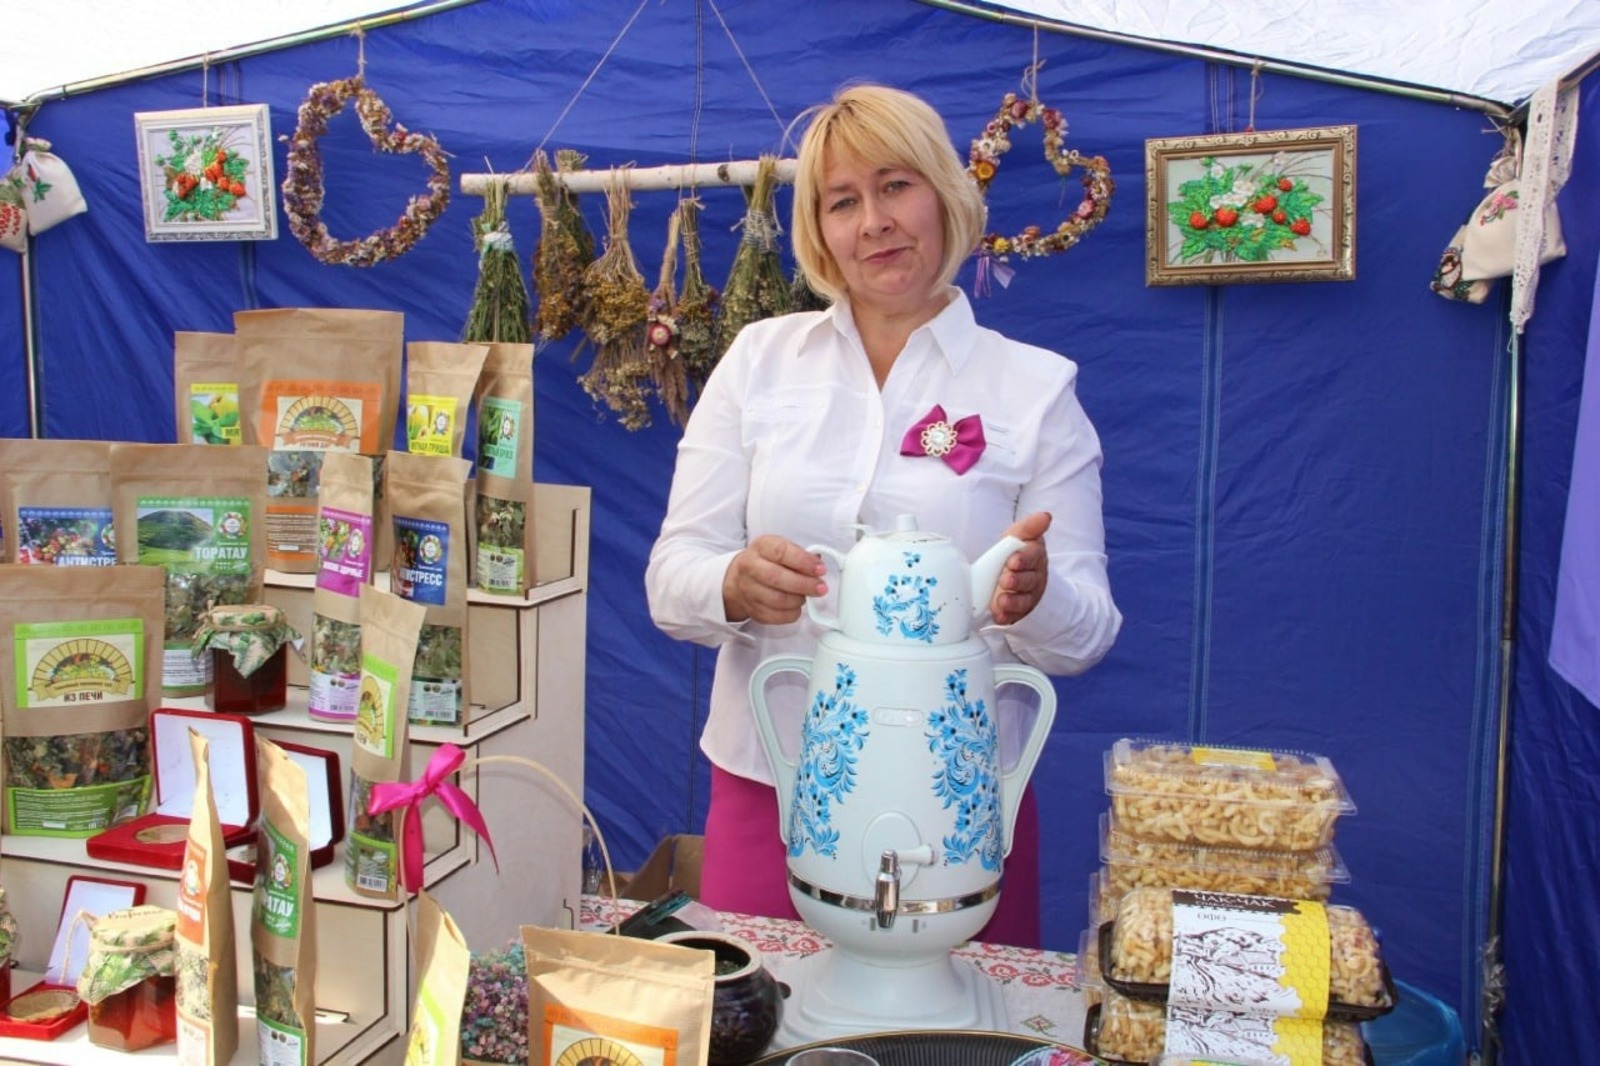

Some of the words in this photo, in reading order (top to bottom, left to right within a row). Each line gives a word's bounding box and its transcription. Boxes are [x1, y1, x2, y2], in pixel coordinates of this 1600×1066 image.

[195, 546, 248, 560] ТОРАТАУ
[64, 693, 77, 701] ИЗ
[79, 691, 103, 701] ПЕЧИ
[1194, 892, 1276, 908] ЧАК-ЧАК
